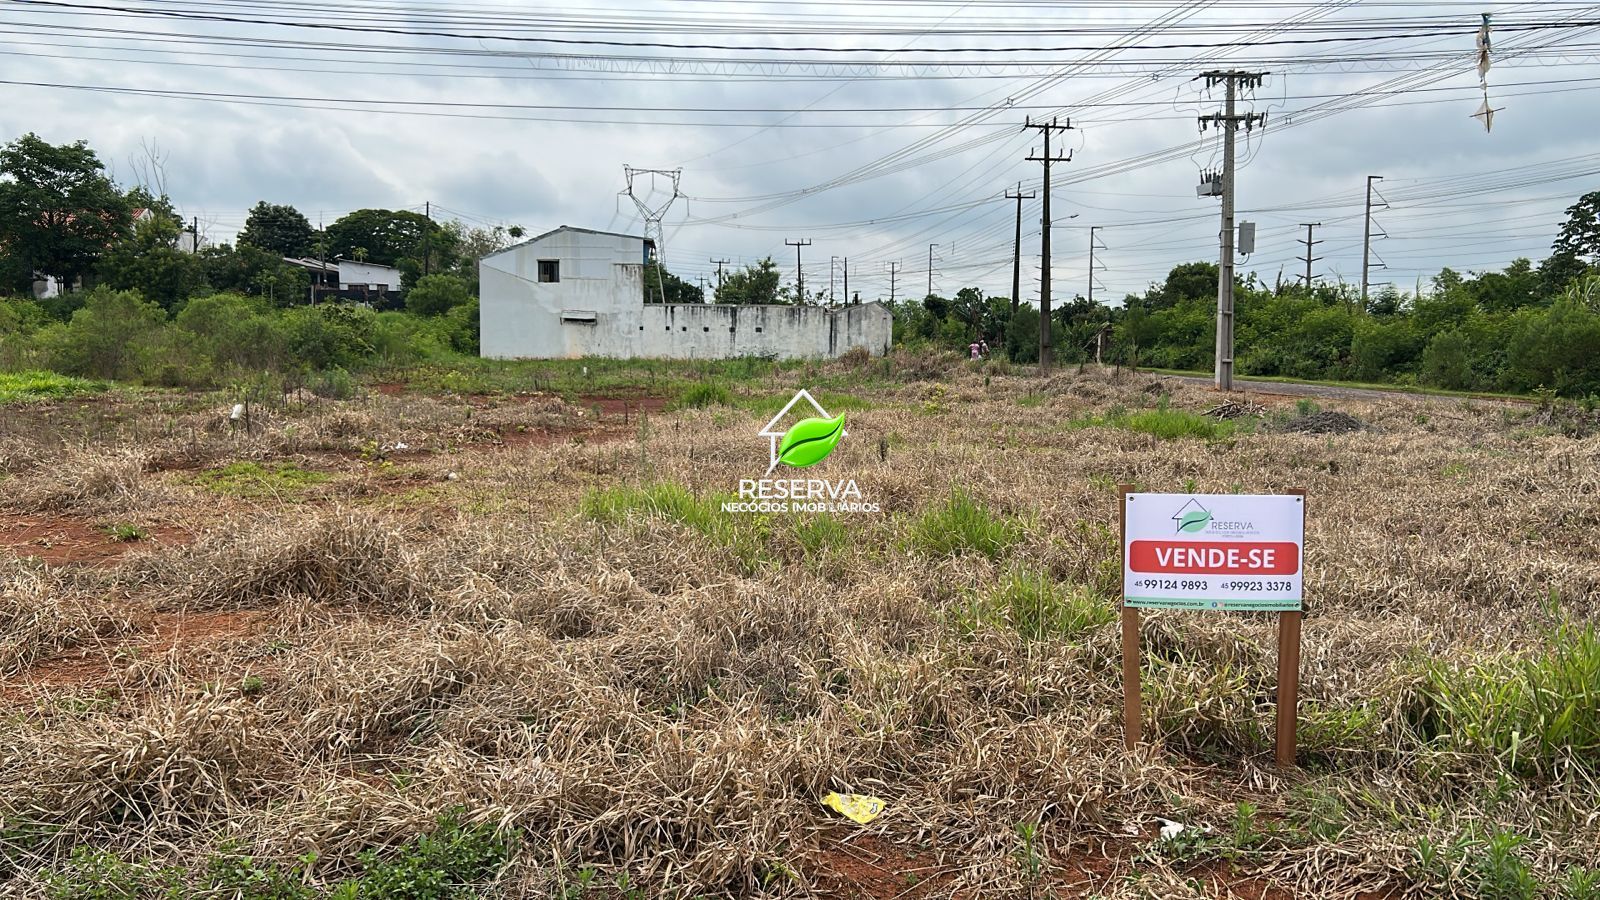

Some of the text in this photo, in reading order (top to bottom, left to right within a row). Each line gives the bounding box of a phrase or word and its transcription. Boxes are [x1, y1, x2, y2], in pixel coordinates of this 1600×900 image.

[1211, 521, 1254, 530] RESERVA
[1155, 547, 1275, 569] VENDE-SE
[1144, 579, 1178, 590] 99124
[1181, 580, 1208, 590] 9893
[1230, 581, 1263, 591] 99923
[1266, 581, 1292, 591] 3378
